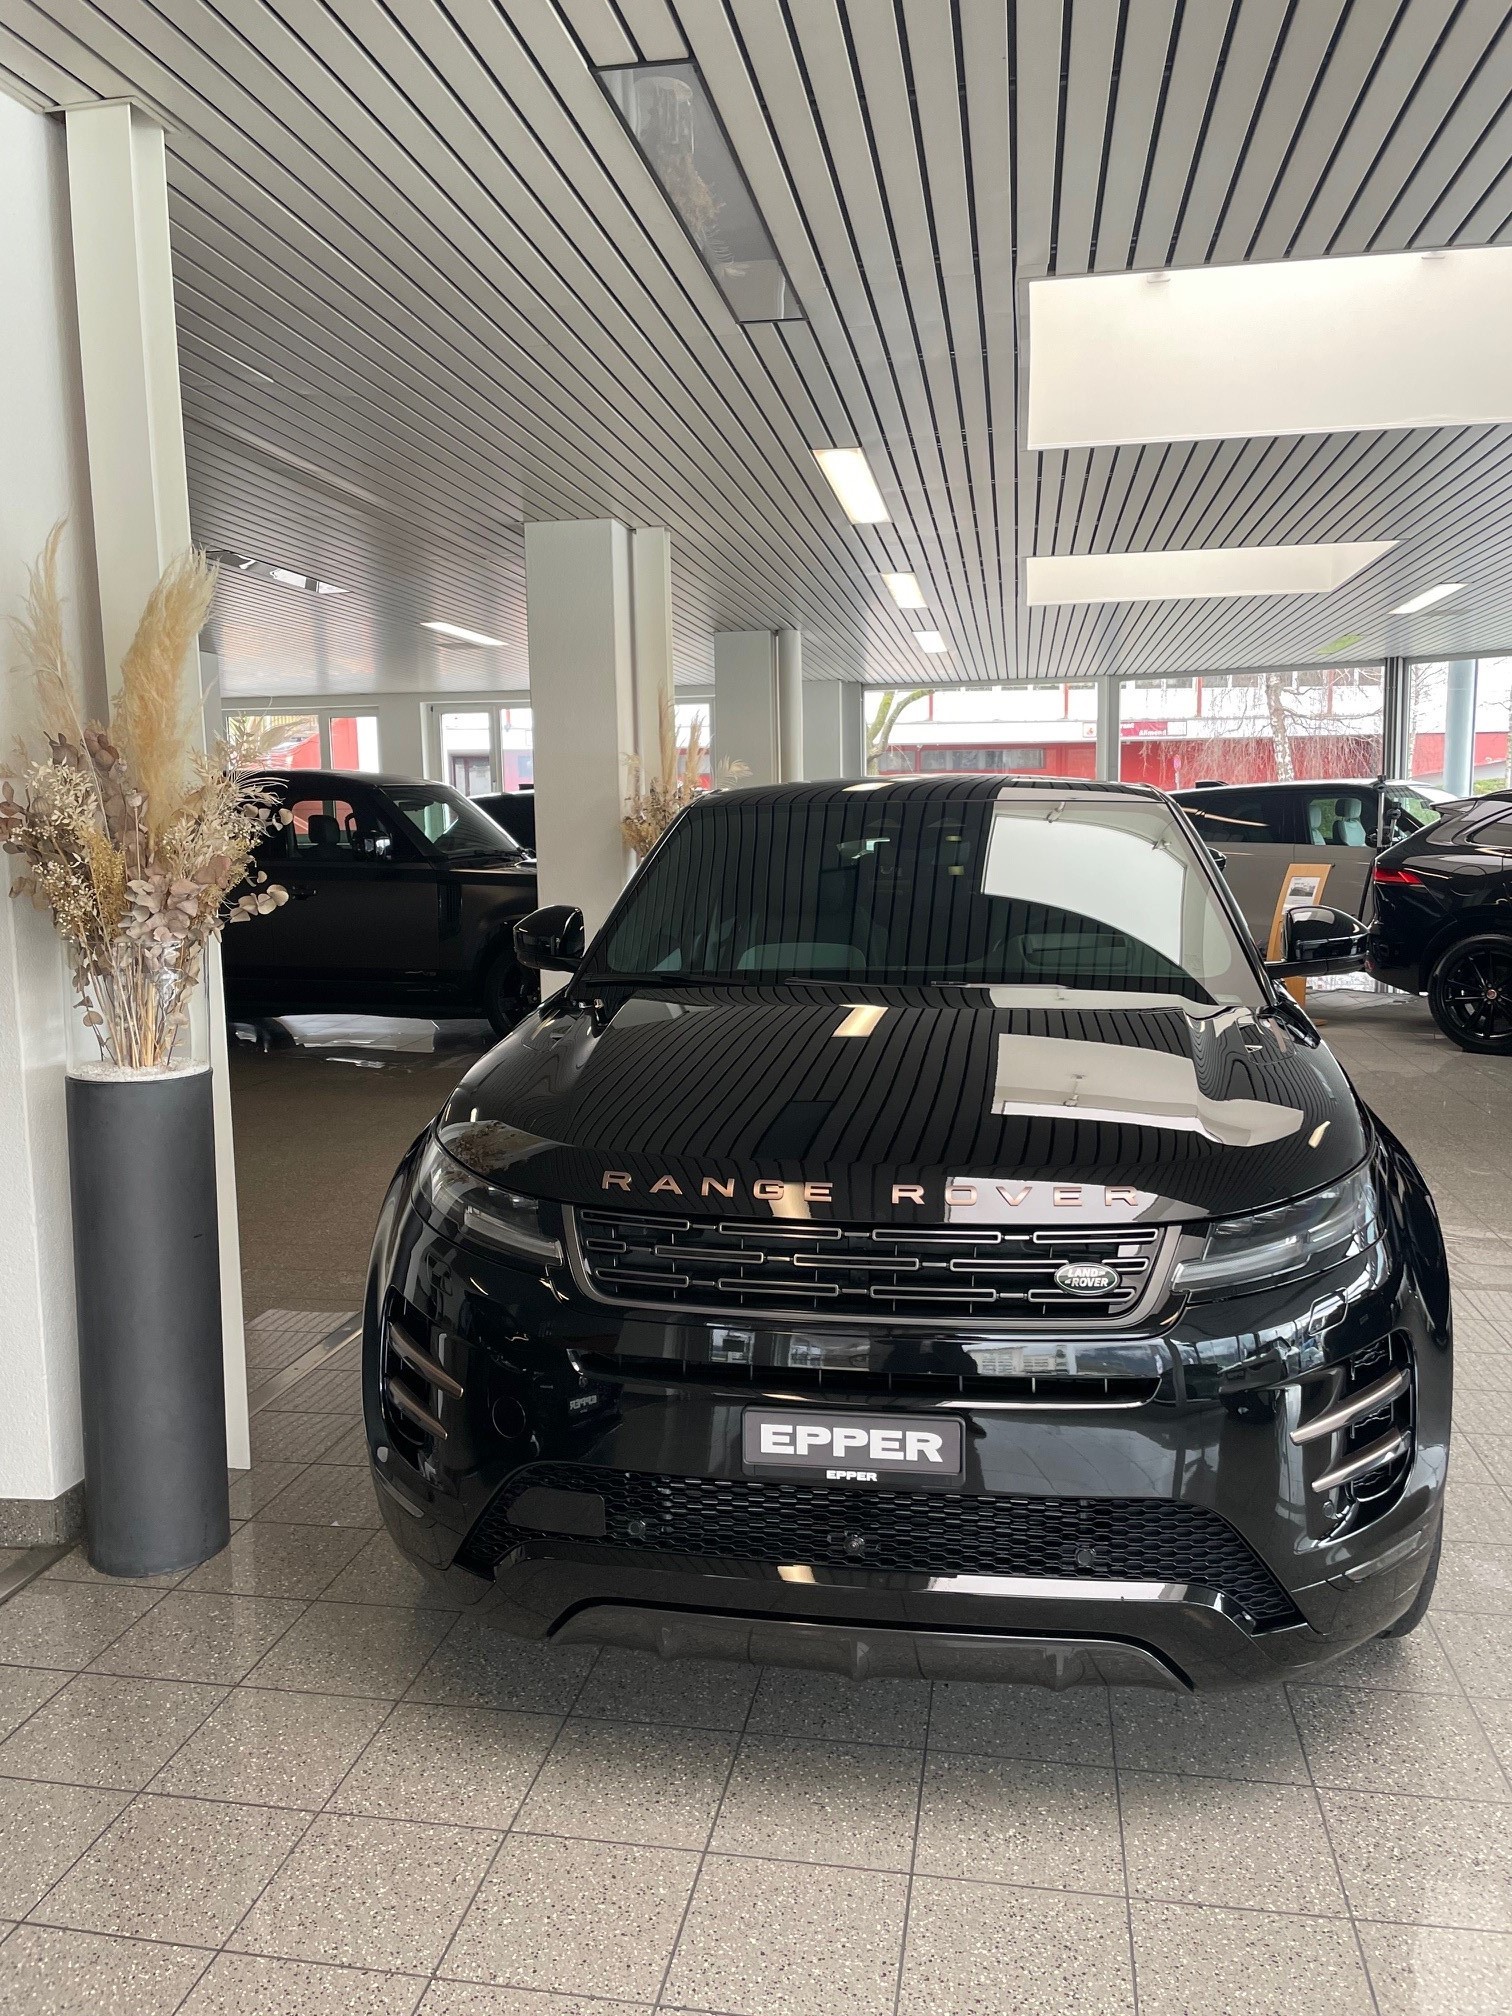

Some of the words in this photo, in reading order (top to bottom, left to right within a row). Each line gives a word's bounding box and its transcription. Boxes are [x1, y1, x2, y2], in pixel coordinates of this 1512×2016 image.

[601, 1171, 834, 1202] RANGE
[891, 1184, 1140, 1207] ROVER
[1067, 1268, 1099, 1277] LAND
[1071, 1277, 1109, 1287] ROVER
[760, 1423, 943, 1462] EPPER
[826, 1470, 878, 1482] EPPER
